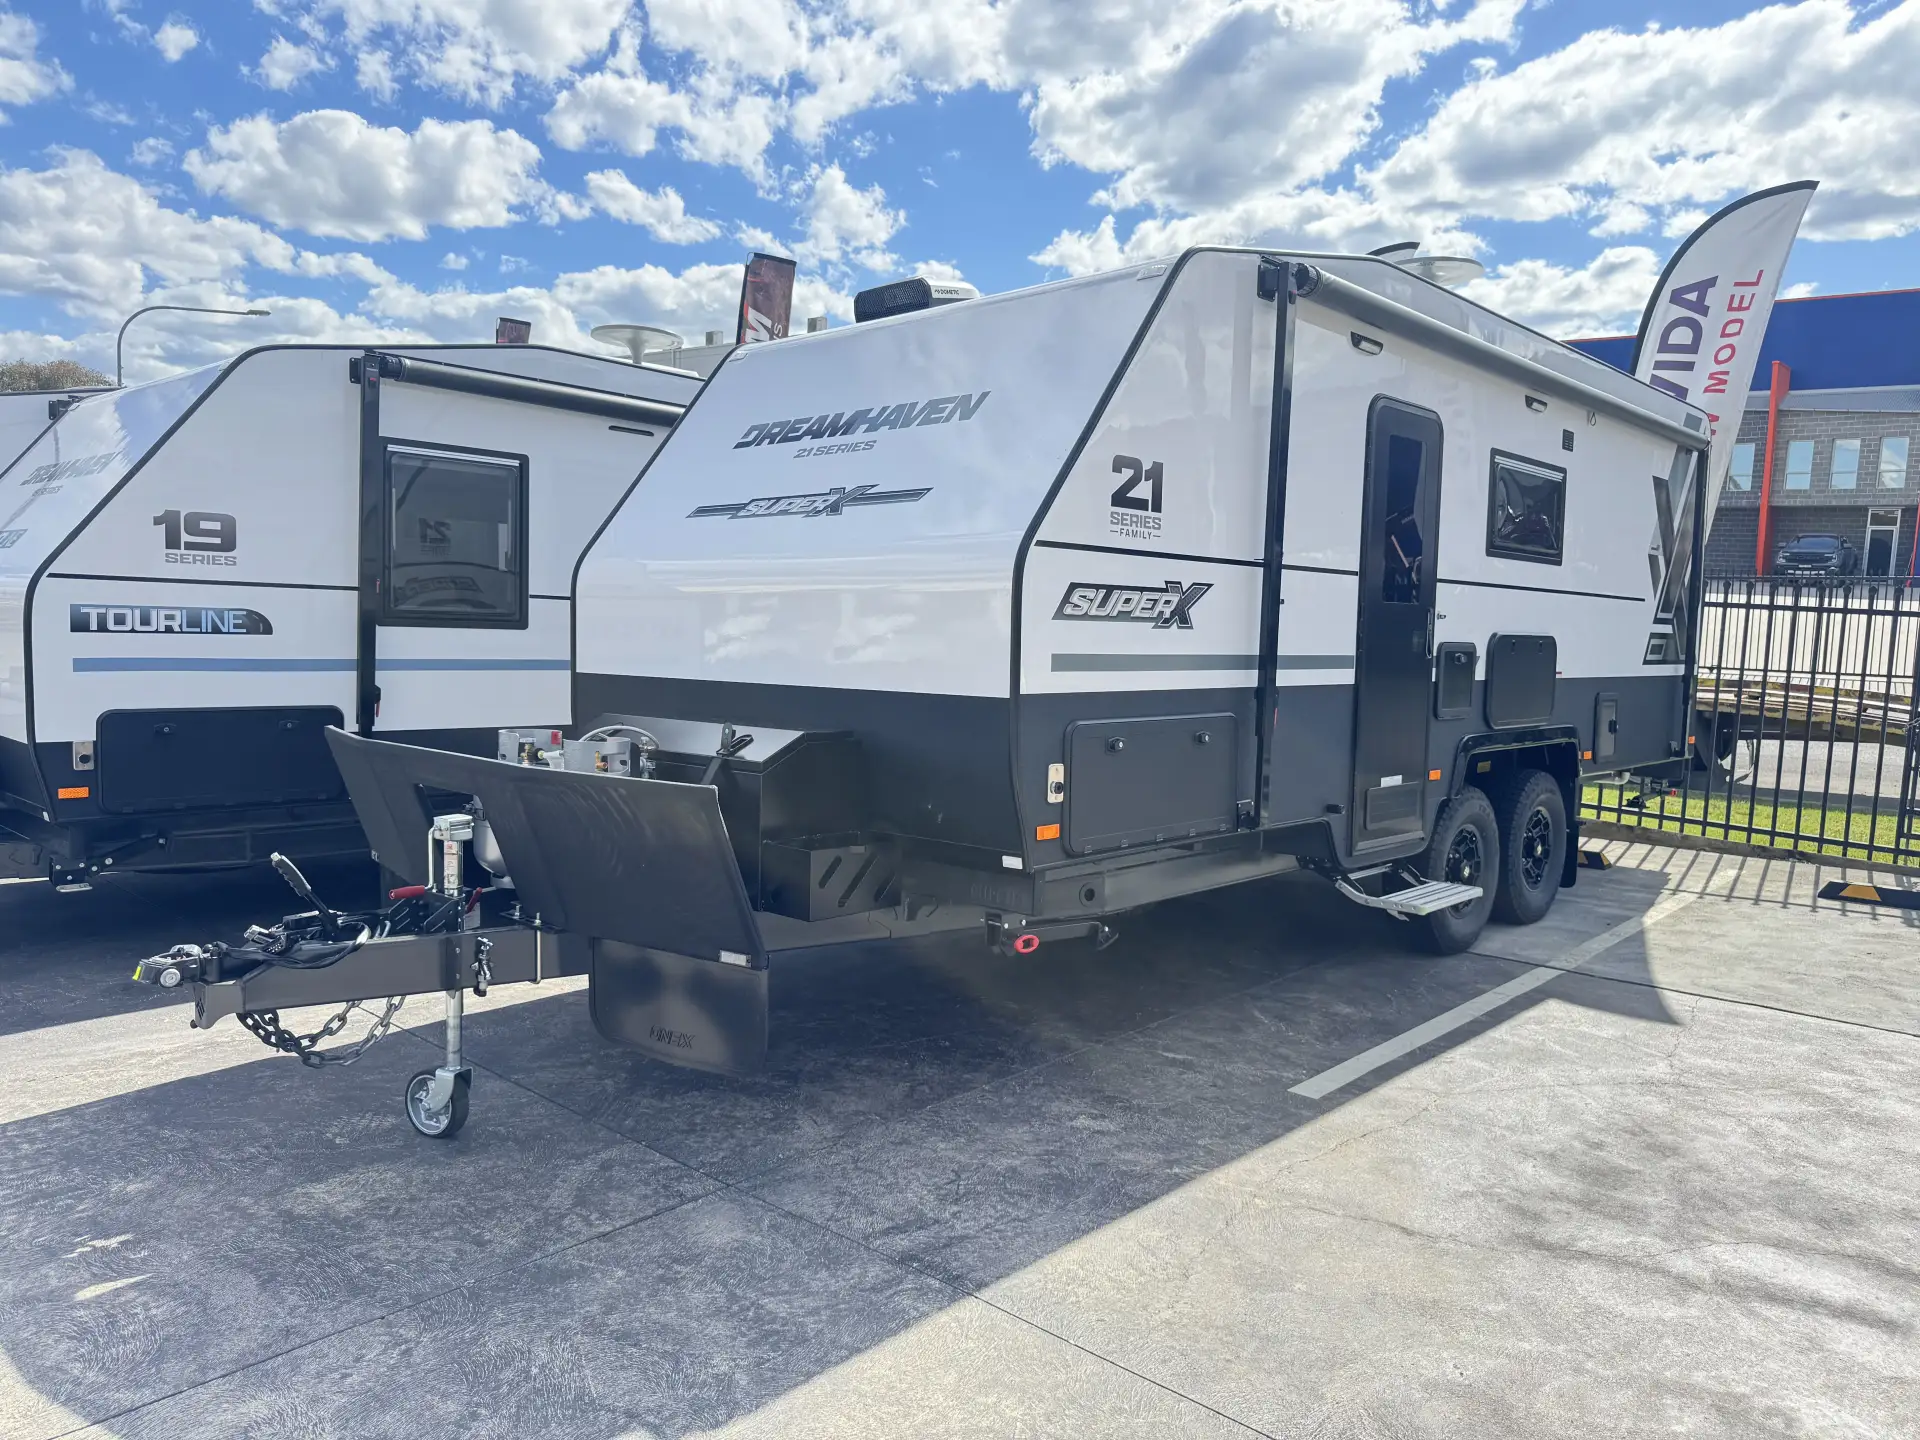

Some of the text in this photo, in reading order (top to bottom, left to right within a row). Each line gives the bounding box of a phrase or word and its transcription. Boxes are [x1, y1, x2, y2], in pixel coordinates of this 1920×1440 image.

[1702, 269, 1764, 394] MODEL
[732, 390, 992, 450] DREAMHAVEN
[793, 440, 877, 459] 21 SERIES
[1111, 454, 1163, 513] 21
[153, 509, 237, 553] 19
[1110, 511, 1162, 530] SERIES
[1119, 528, 1152, 540] FAMILY
[164, 552, 237, 567] SERIES
[80, 606, 247, 633] TOURLINE
